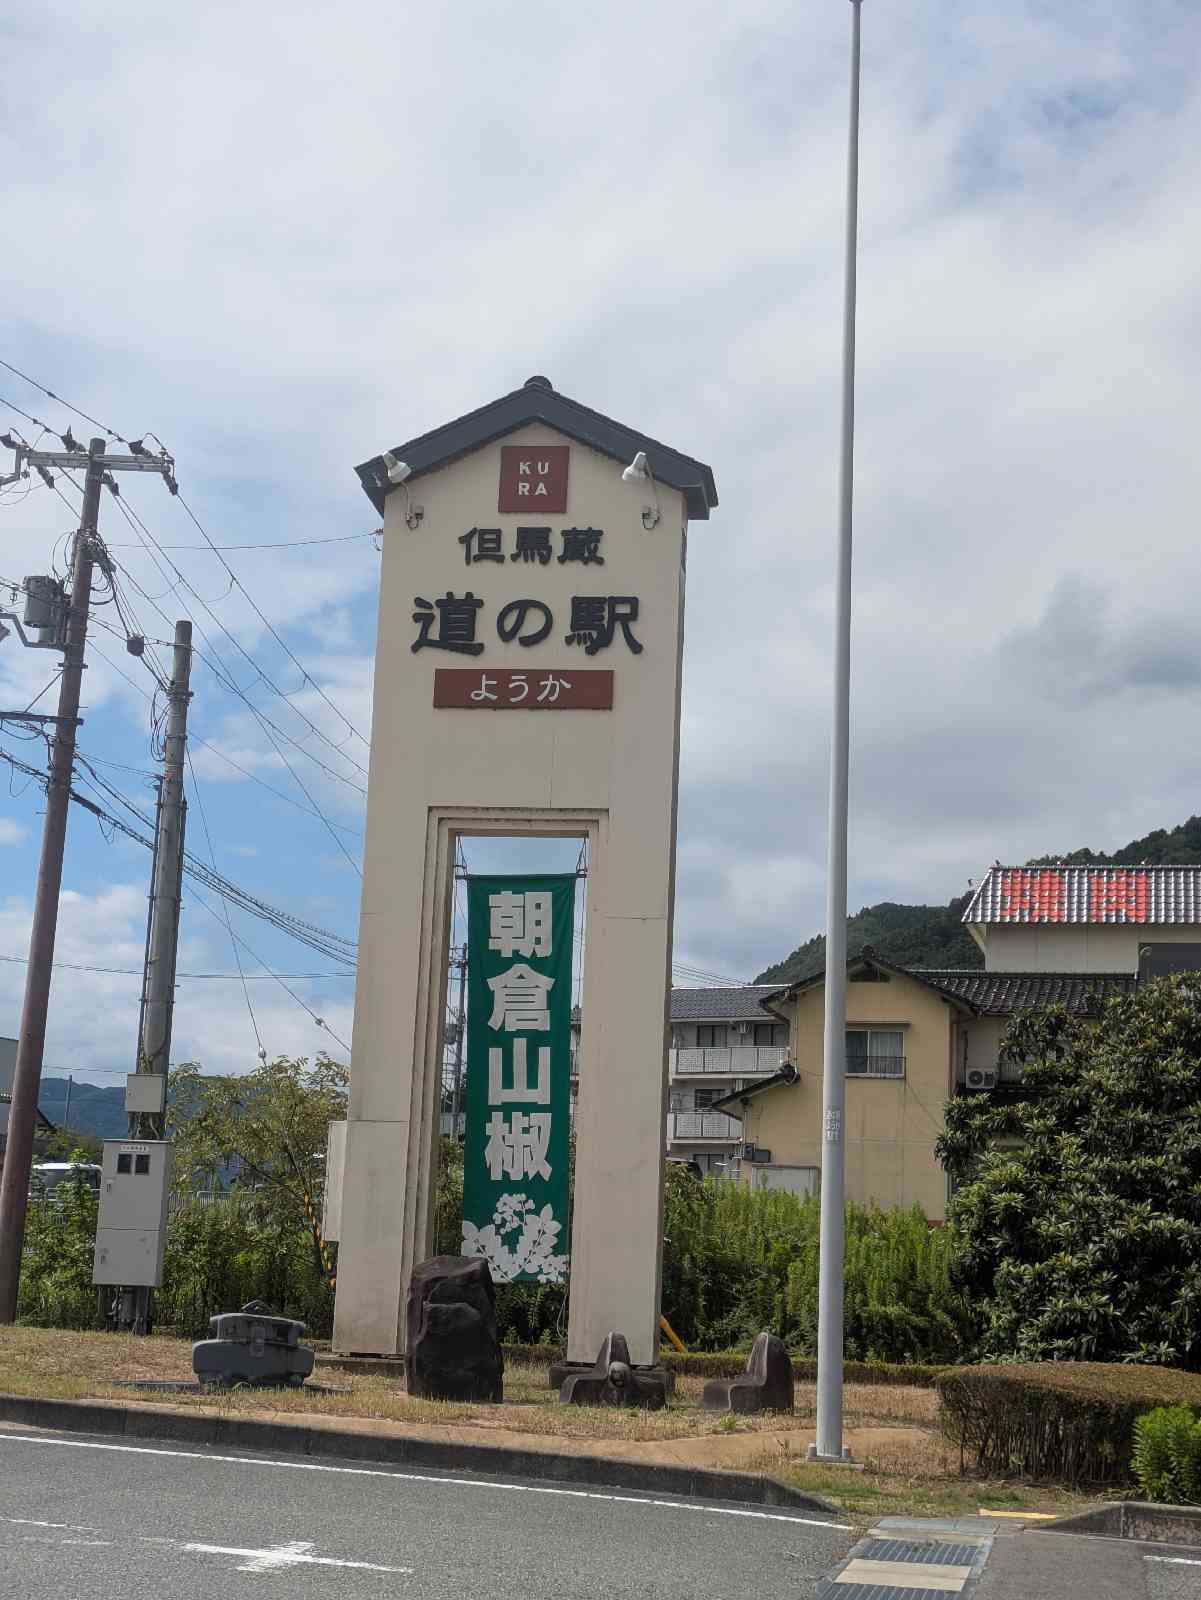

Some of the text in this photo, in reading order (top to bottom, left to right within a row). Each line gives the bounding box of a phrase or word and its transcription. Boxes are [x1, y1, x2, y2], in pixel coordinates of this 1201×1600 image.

[519, 461, 549, 475] KU
[518, 482, 548, 496] RA
[458, 527, 605, 565] 但馬蔵
[410, 591, 643, 656] 道の駅
[470, 674, 572, 702] ようか
[484, 890, 556, 1182] 朝倉山椒
